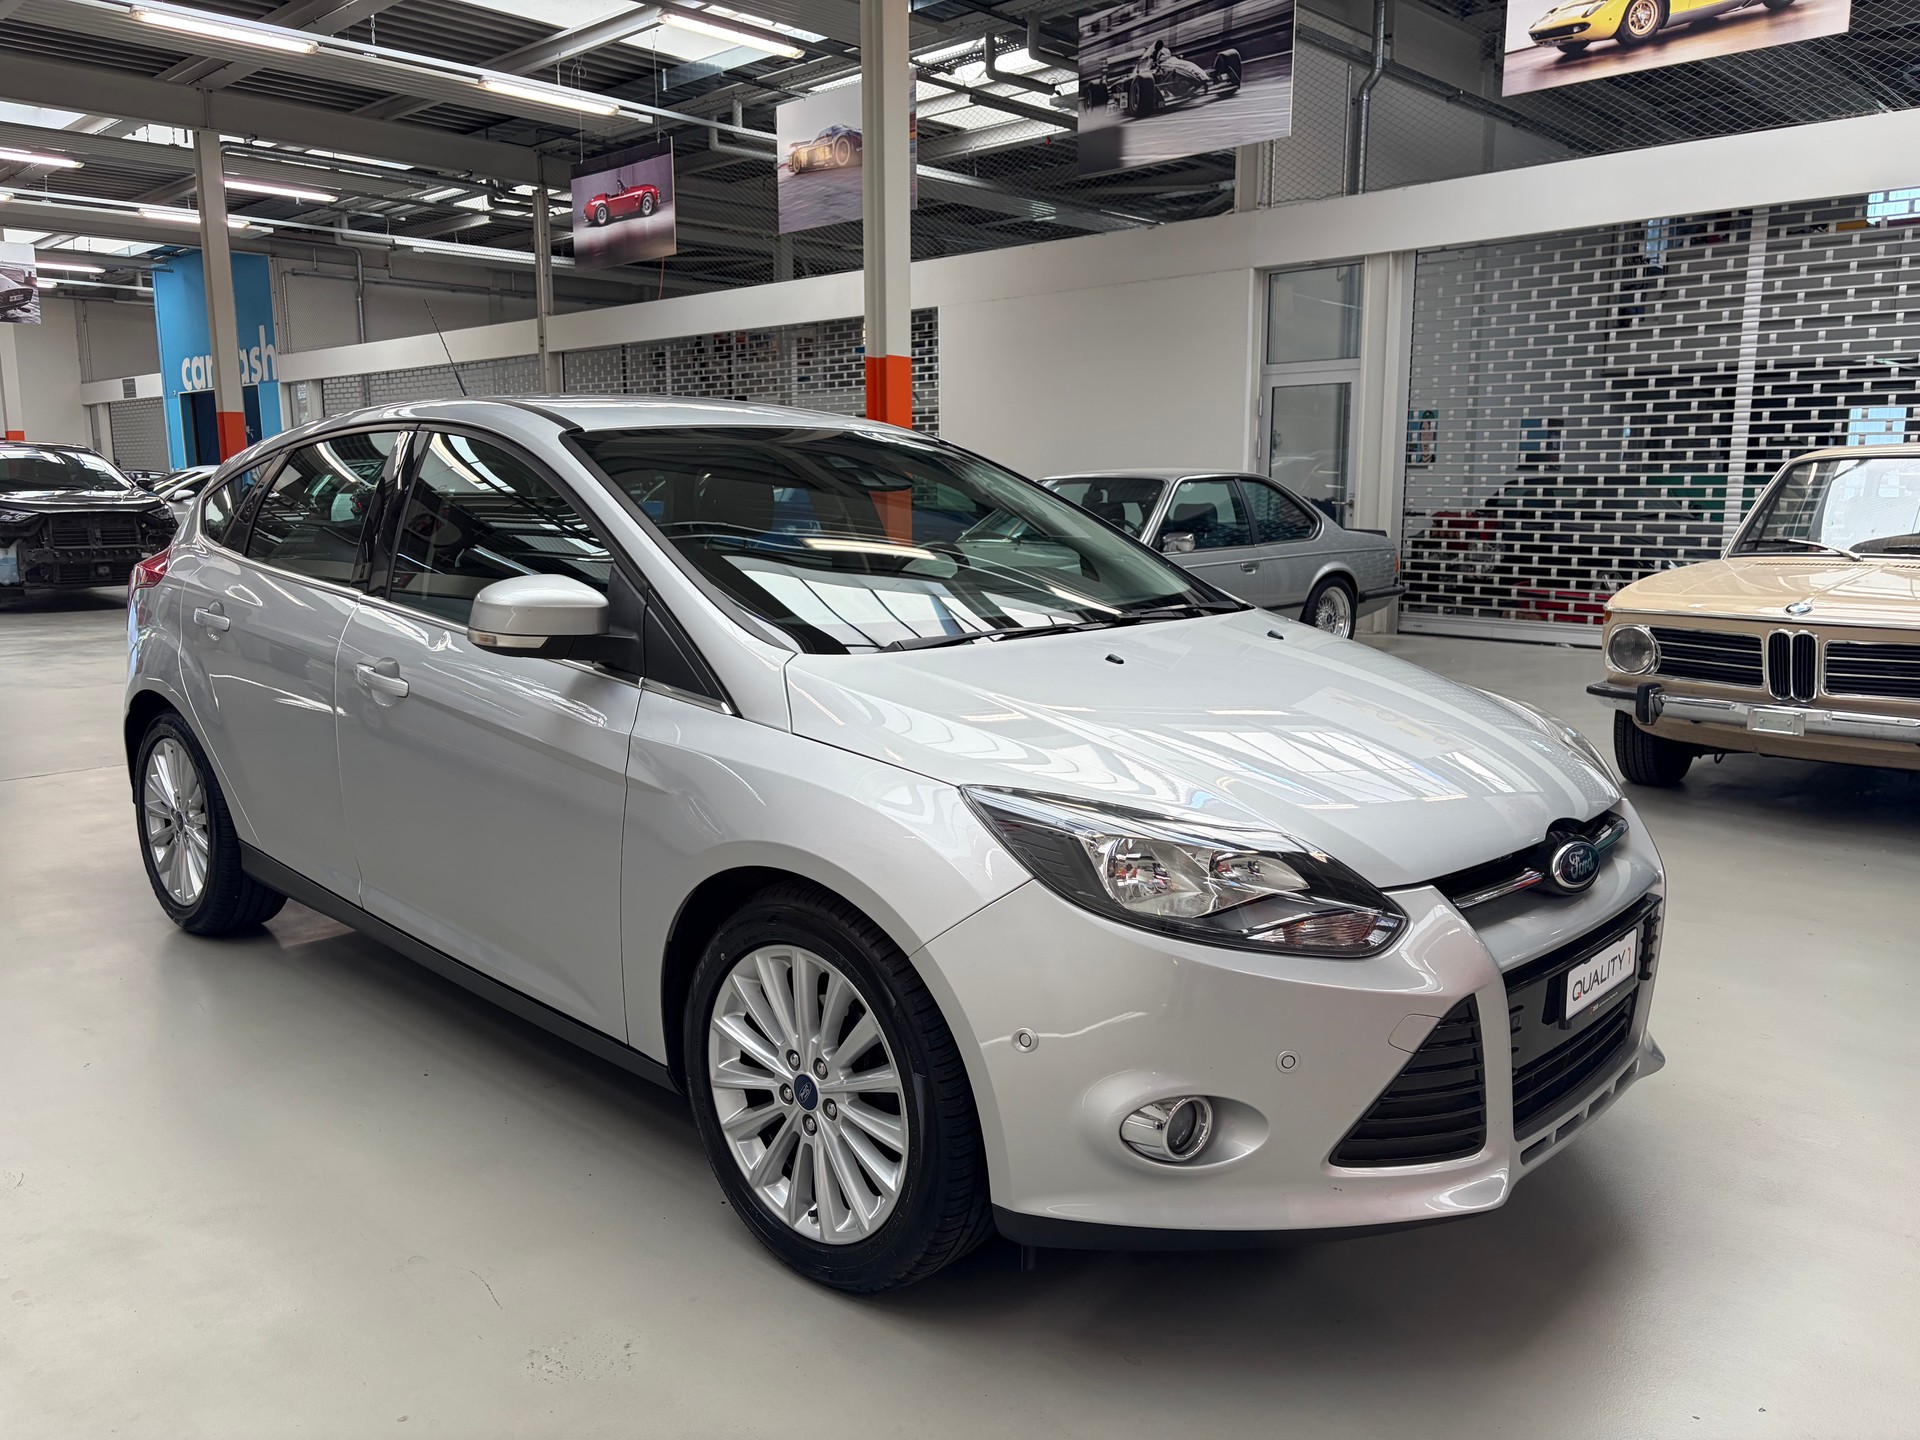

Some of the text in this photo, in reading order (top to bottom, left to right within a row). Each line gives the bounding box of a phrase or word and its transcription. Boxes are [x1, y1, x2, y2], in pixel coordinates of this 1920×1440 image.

[181, 325, 278, 391] carash
[1569, 848, 1595, 879] Ford
[1572, 949, 1626, 1001] QUALITY
